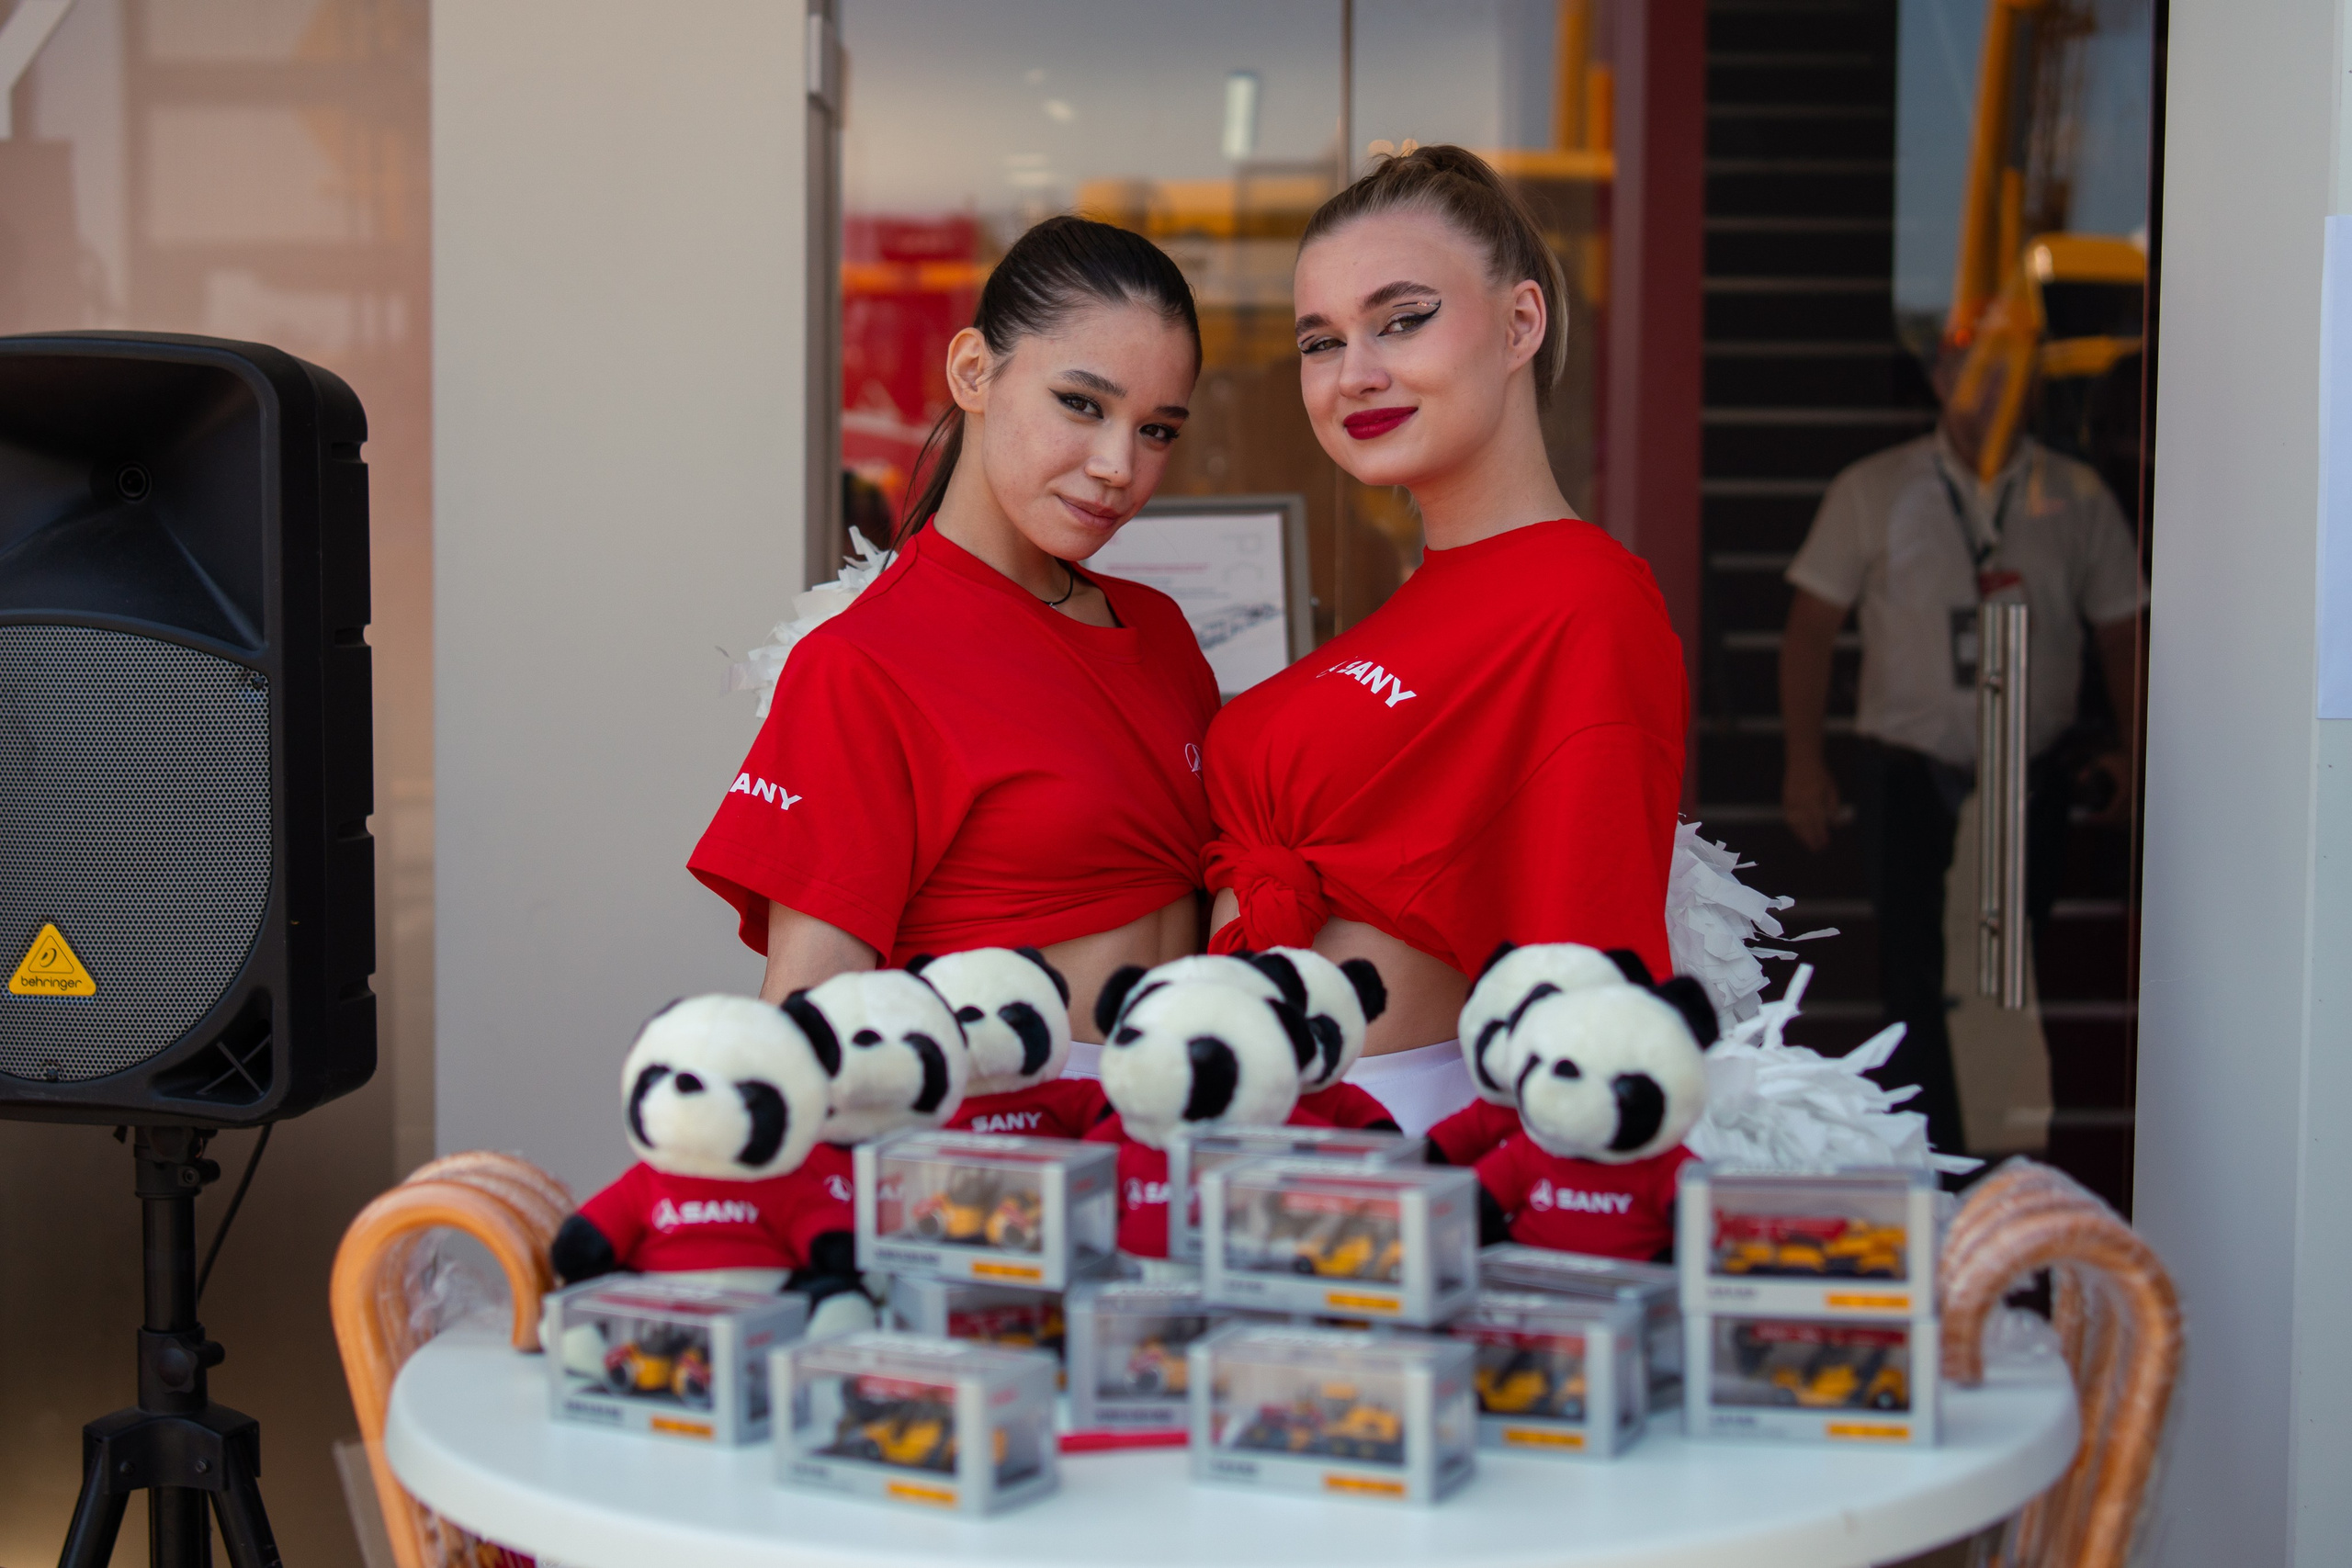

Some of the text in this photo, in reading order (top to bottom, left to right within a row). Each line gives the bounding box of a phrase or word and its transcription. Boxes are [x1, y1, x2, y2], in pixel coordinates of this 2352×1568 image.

[729, 773, 803, 811] ANY
[20, 976, 83, 991] behringer
[971, 1111, 1043, 1132] SANY
[678, 1199, 760, 1224] SANY
[1555, 1187, 1634, 1214] SANY
